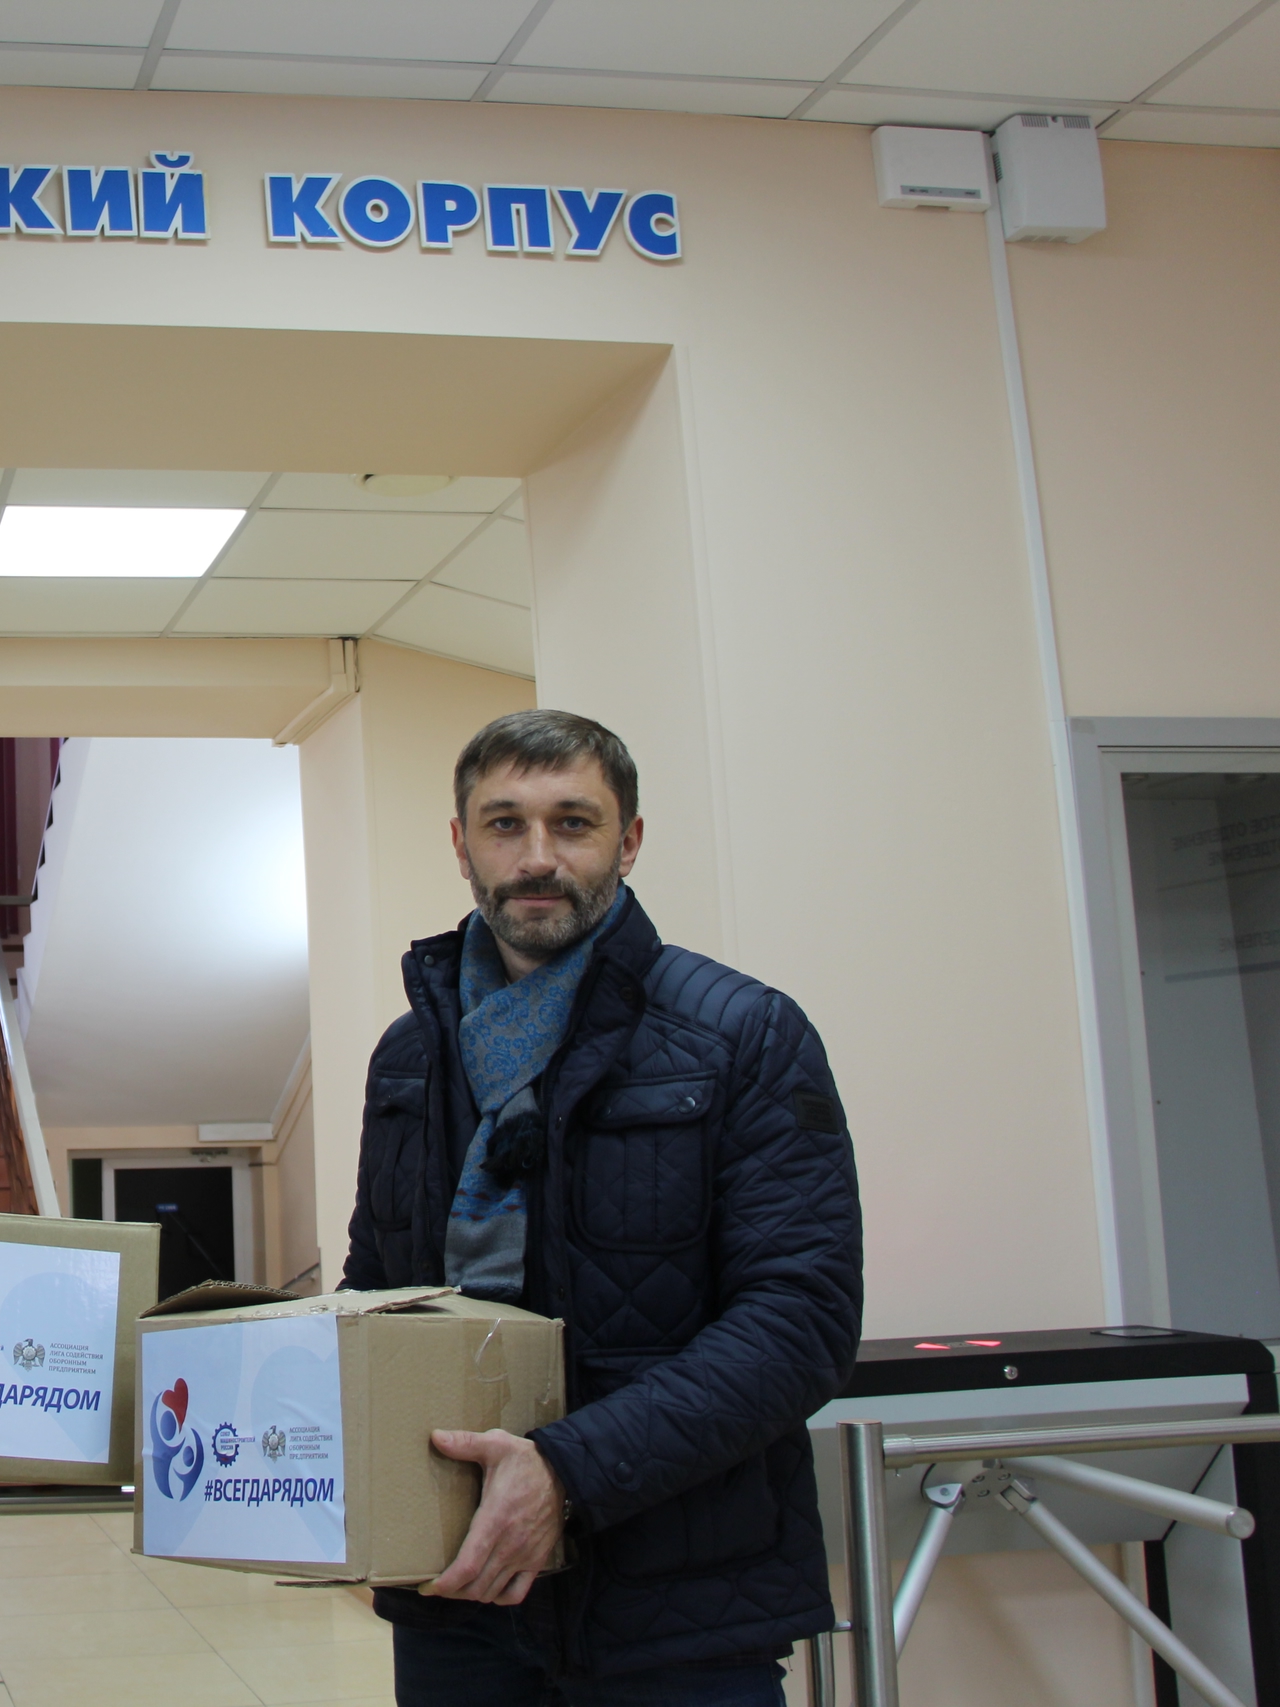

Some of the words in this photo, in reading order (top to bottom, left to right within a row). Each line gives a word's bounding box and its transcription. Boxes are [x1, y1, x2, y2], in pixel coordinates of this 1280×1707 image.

[264, 173, 682, 261] КОРПУС
[49, 1343, 89, 1351] АССОЦИАЦИЯ
[65, 1351, 104, 1360] СОДЕЙСТВИЯ
[48, 1358, 87, 1366] ОБОРОННЫМ
[48, 1365, 97, 1374] ПРЕДПРИЯТИЯМ
[204, 1478, 335, 1507] #ВСЕГДАРЯДОМ
